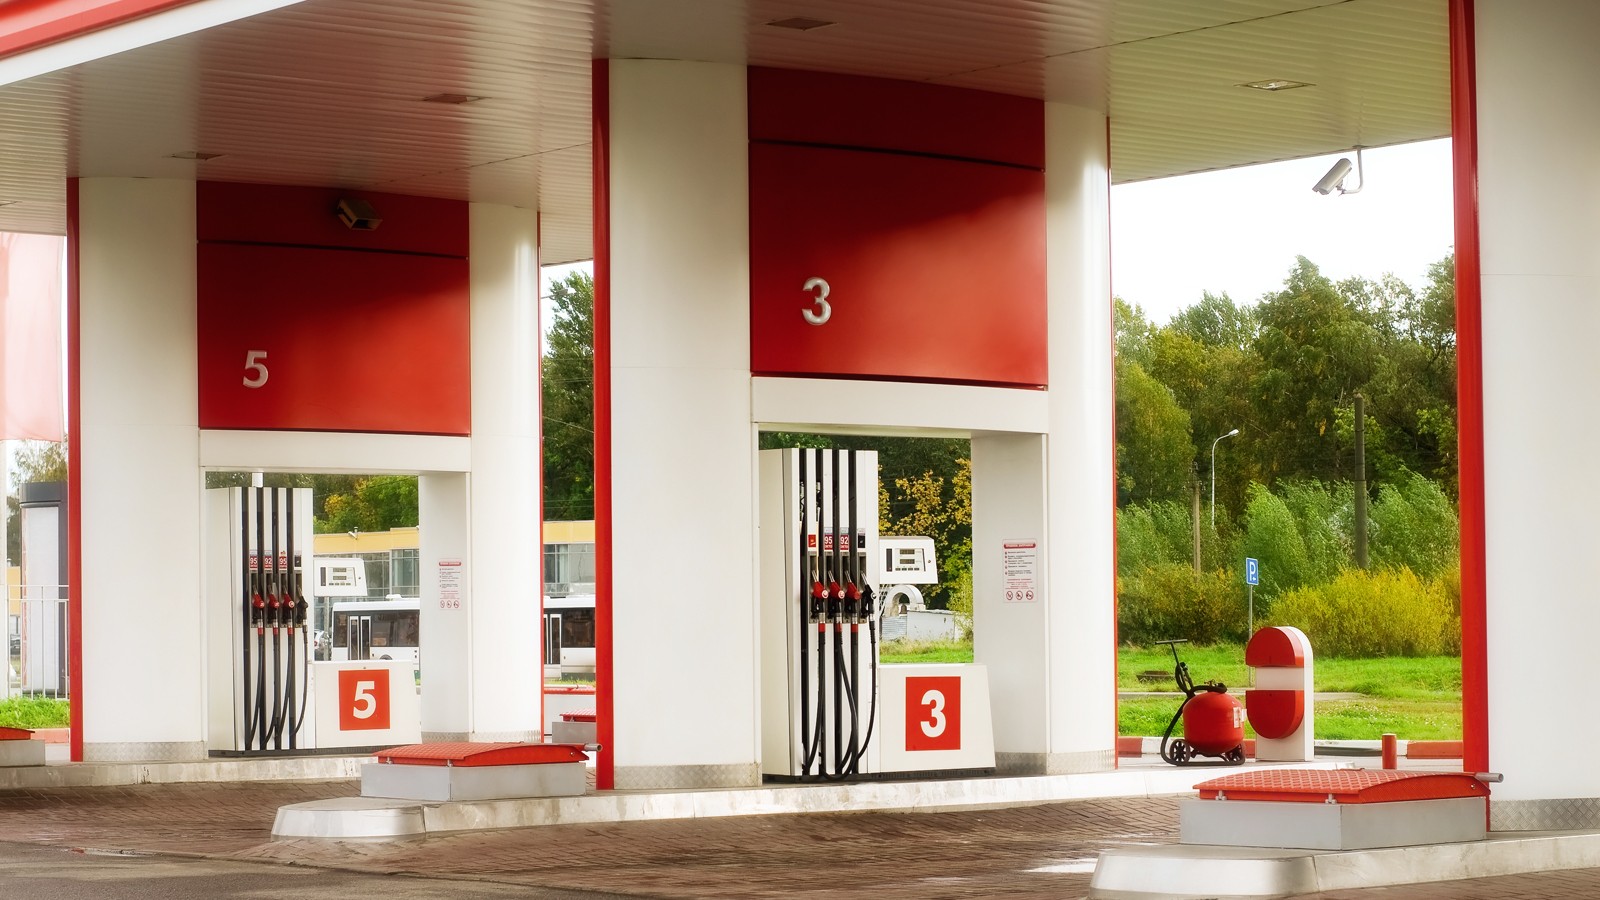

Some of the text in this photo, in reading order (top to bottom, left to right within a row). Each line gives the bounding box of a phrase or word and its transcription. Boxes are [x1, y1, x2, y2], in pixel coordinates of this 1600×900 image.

[801, 276, 832, 326] 3
[242, 349, 269, 389] 5
[824, 536, 833, 545] 95
[840, 536, 848, 545] 92
[264, 557, 272, 565] 92
[1250, 562, 1256, 581] P
[352, 680, 377, 720] 5
[920, 689, 947, 738] 3
